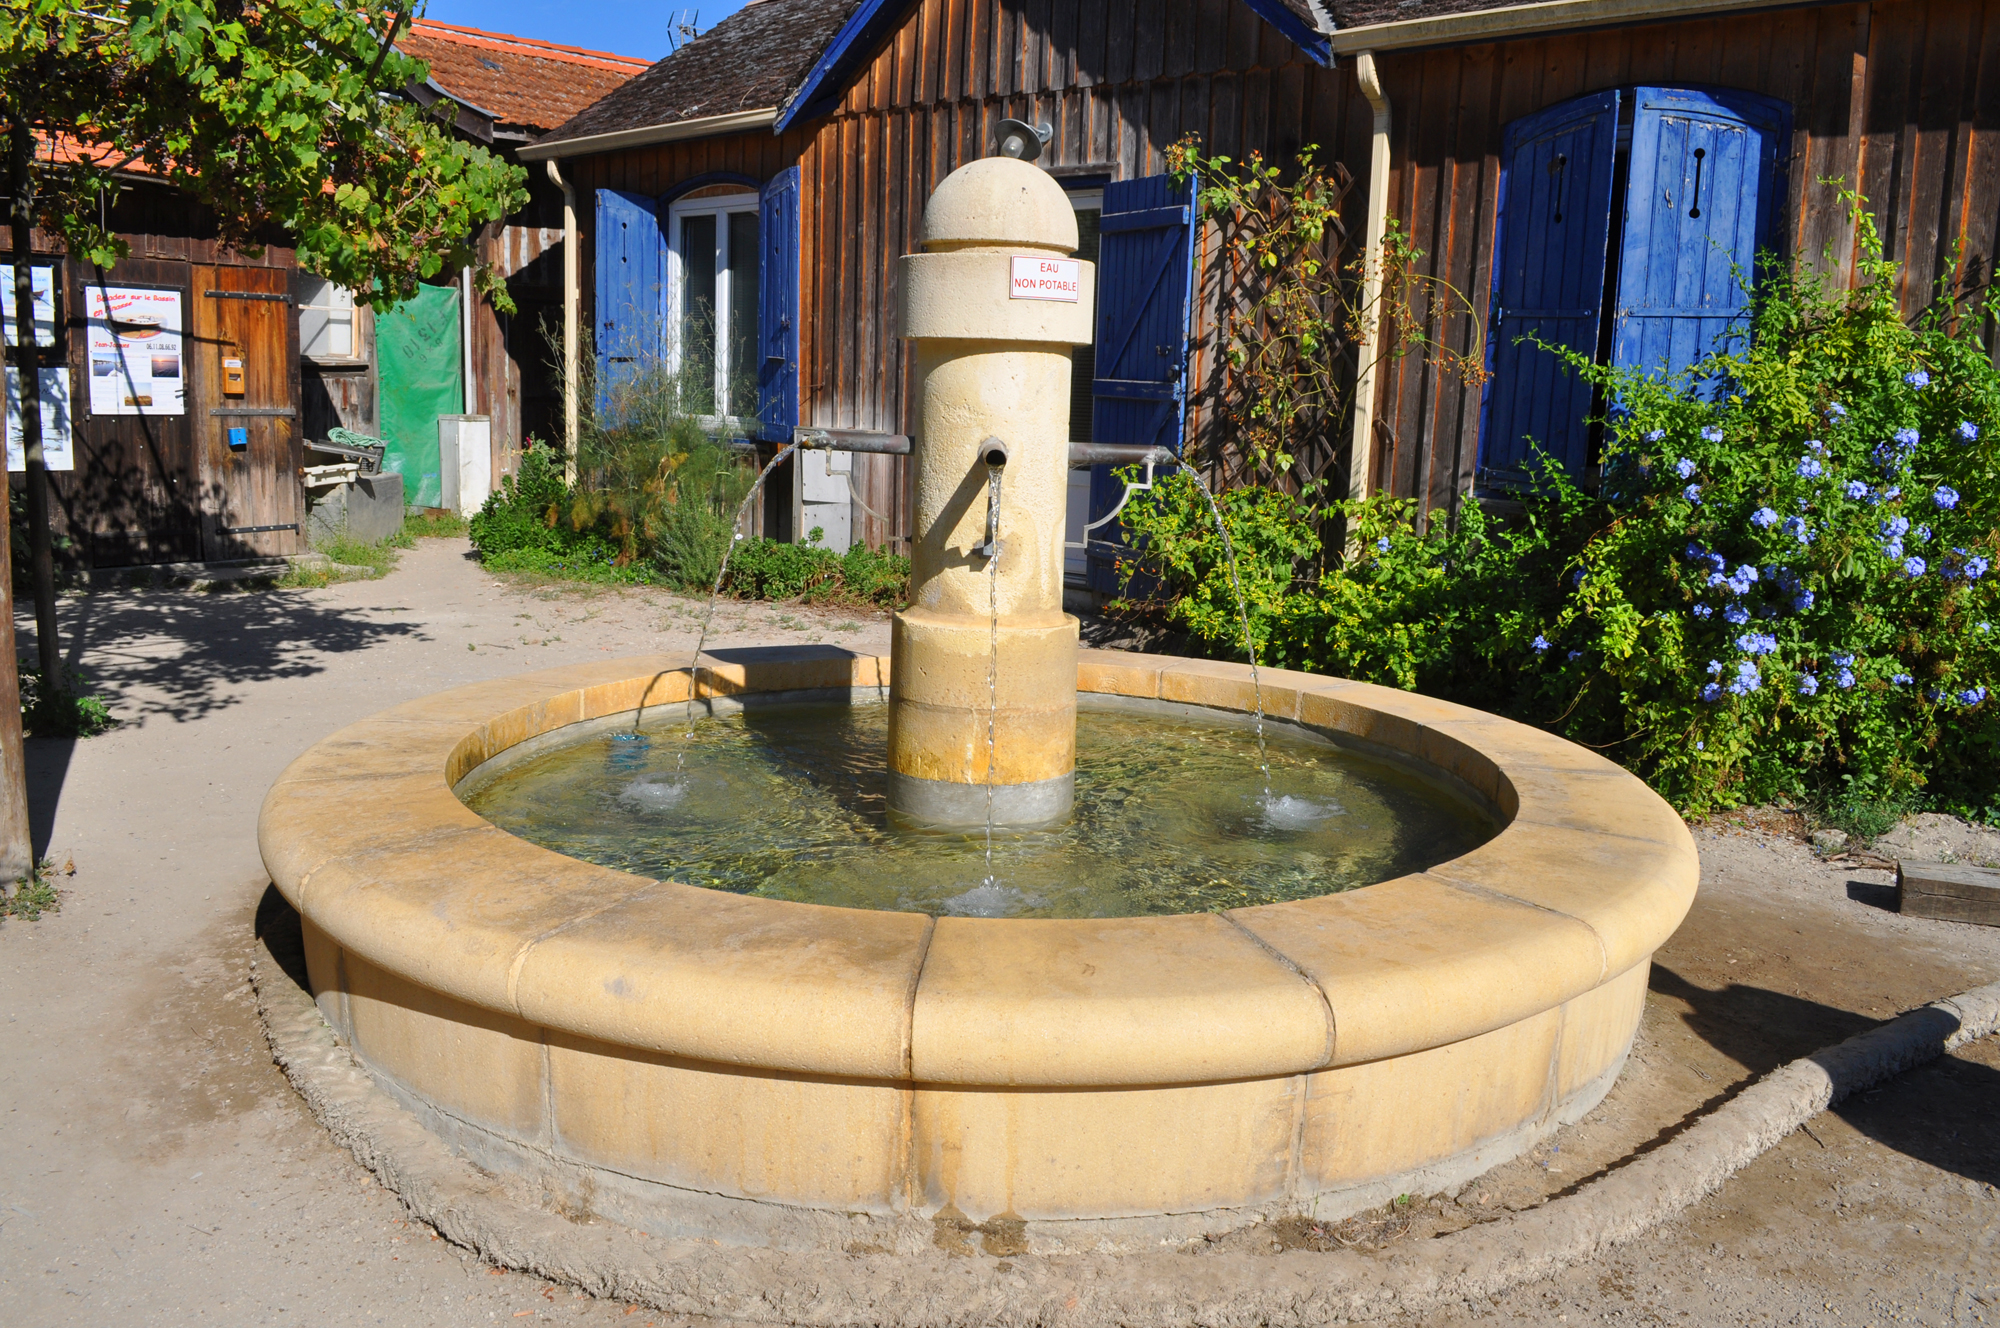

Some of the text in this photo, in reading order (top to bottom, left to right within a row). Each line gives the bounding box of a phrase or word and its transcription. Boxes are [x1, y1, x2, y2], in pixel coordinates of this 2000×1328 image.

[1040, 263, 1059, 273] EAU
[1014, 278, 1077, 292] NON POTABLE
[96, 294, 126, 303] Balades
[153, 294, 175, 302] Bassin
[93, 308, 103, 317] en
